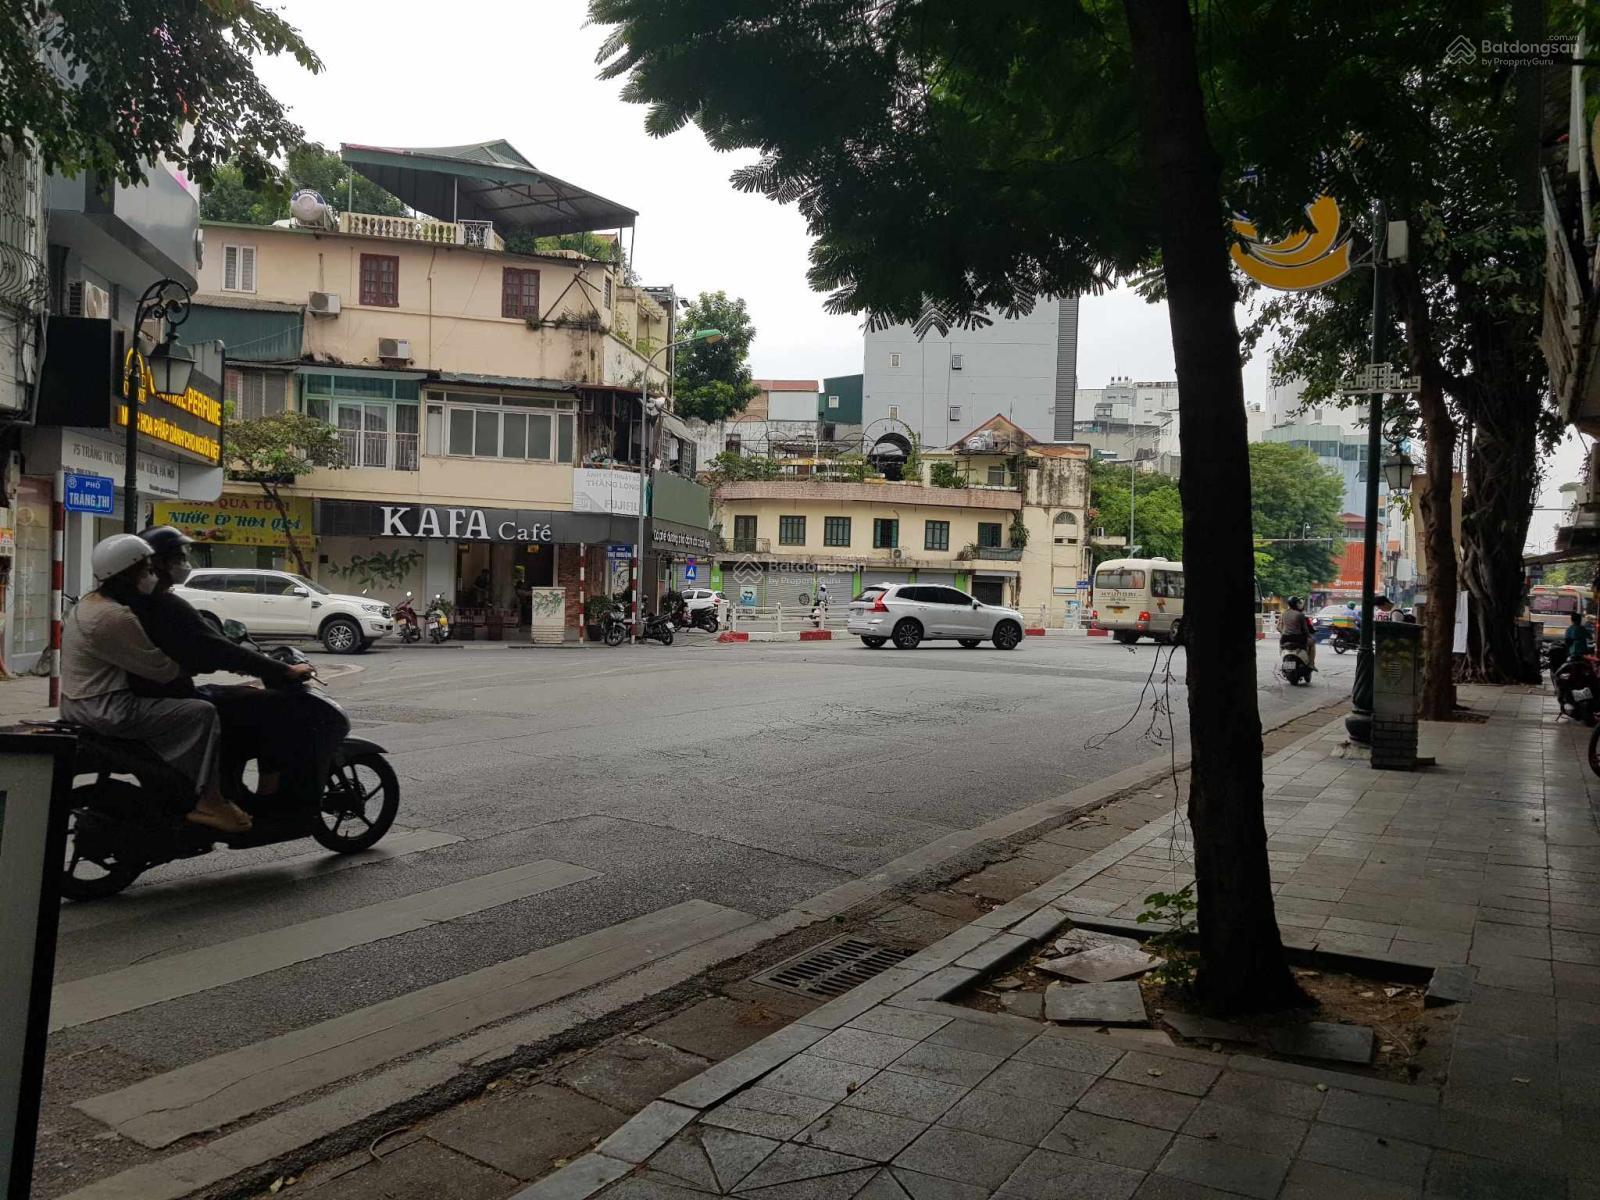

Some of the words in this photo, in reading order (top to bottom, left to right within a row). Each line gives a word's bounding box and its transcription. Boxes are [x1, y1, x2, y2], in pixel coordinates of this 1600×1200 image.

[188, 386, 222, 427] PERFUME
[85, 479, 101, 489] PHỐ
[380, 506, 491, 540] KAFA
[498, 521, 552, 541] Café
